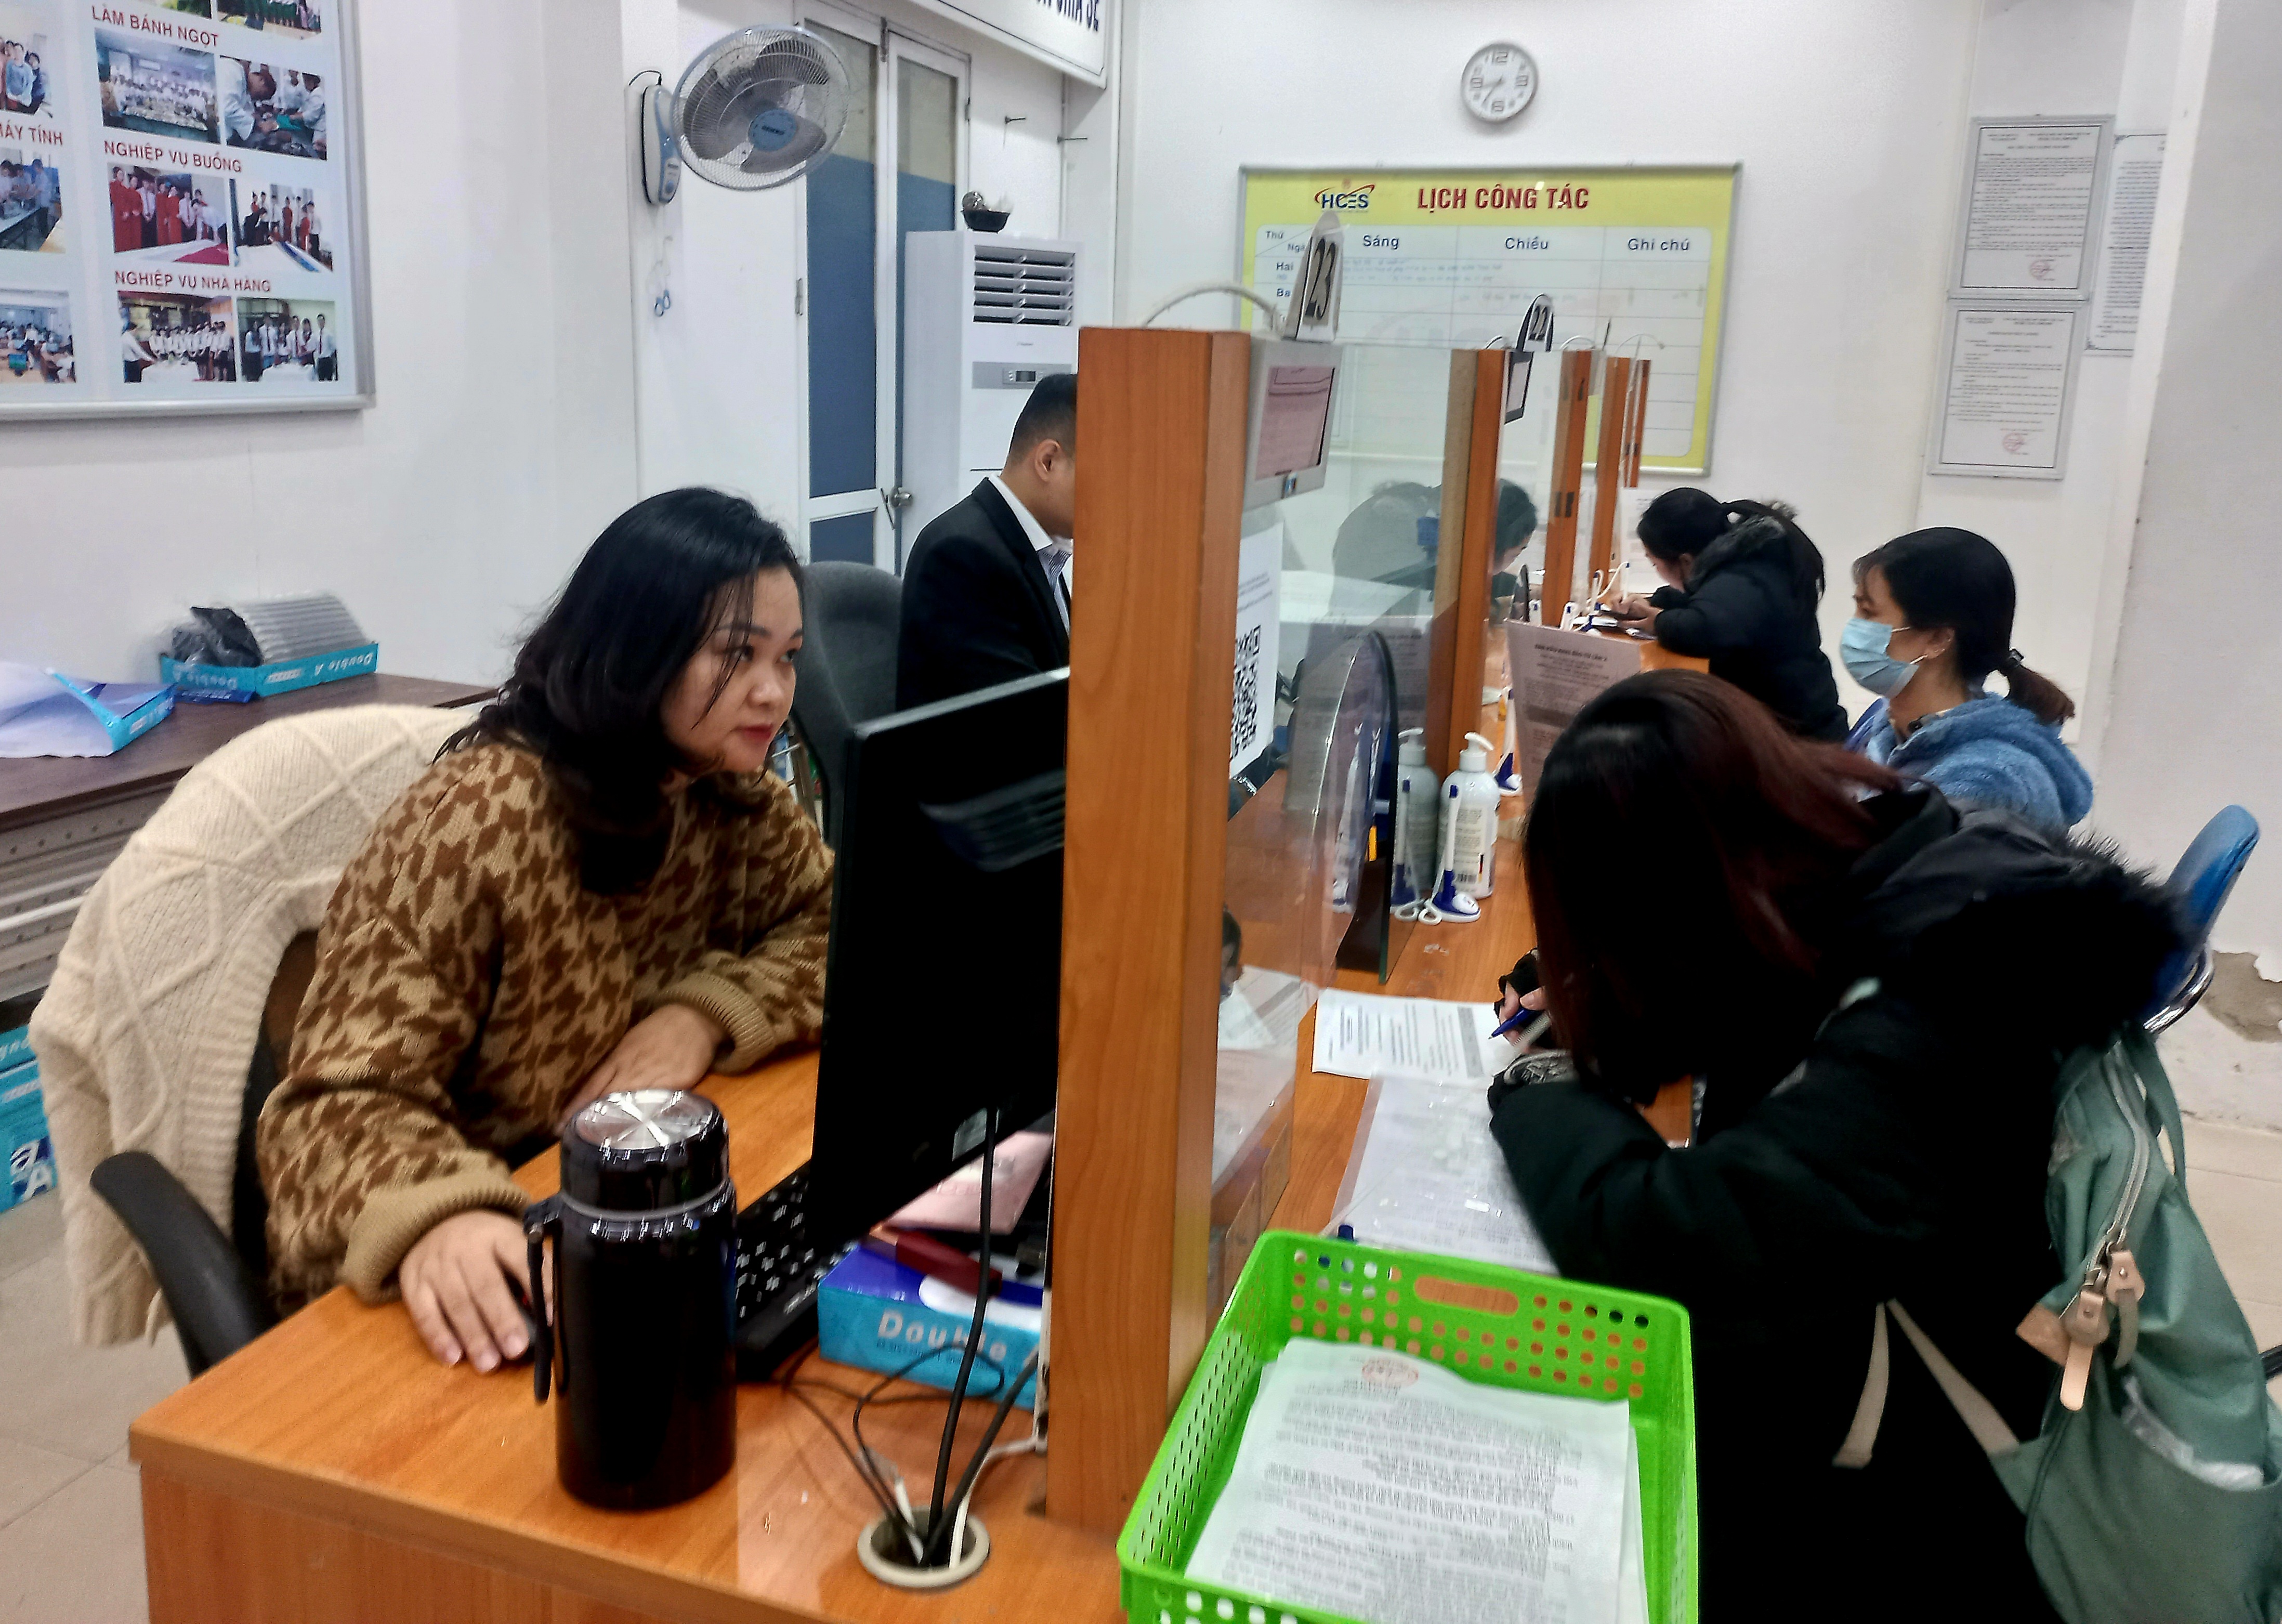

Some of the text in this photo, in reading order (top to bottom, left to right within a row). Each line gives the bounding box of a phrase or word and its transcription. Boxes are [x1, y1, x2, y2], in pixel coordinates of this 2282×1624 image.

[130, 14, 172, 37] BÁNH
[178, 26, 219, 48] NGỌT
[28, 124, 63, 146] TÍNH
[104, 141, 163, 163] NGHIỆP
[169, 150, 188, 167] VỤ
[1321, 194, 1369, 208] HCES
[1418, 183, 1589, 213] LỊCH CÔNG TÁC
[1363, 234, 1399, 250] Sáng
[1628, 238, 1689, 251] Ghi chú
[1276, 262, 1294, 271] Hai
[115, 270, 271, 292] NGHIỆP VỤ NHÀ HÀNG
[1305, 237, 1338, 320] 23
[1277, 288, 1291, 297] Ba
[1528, 305, 1548, 340] 22
